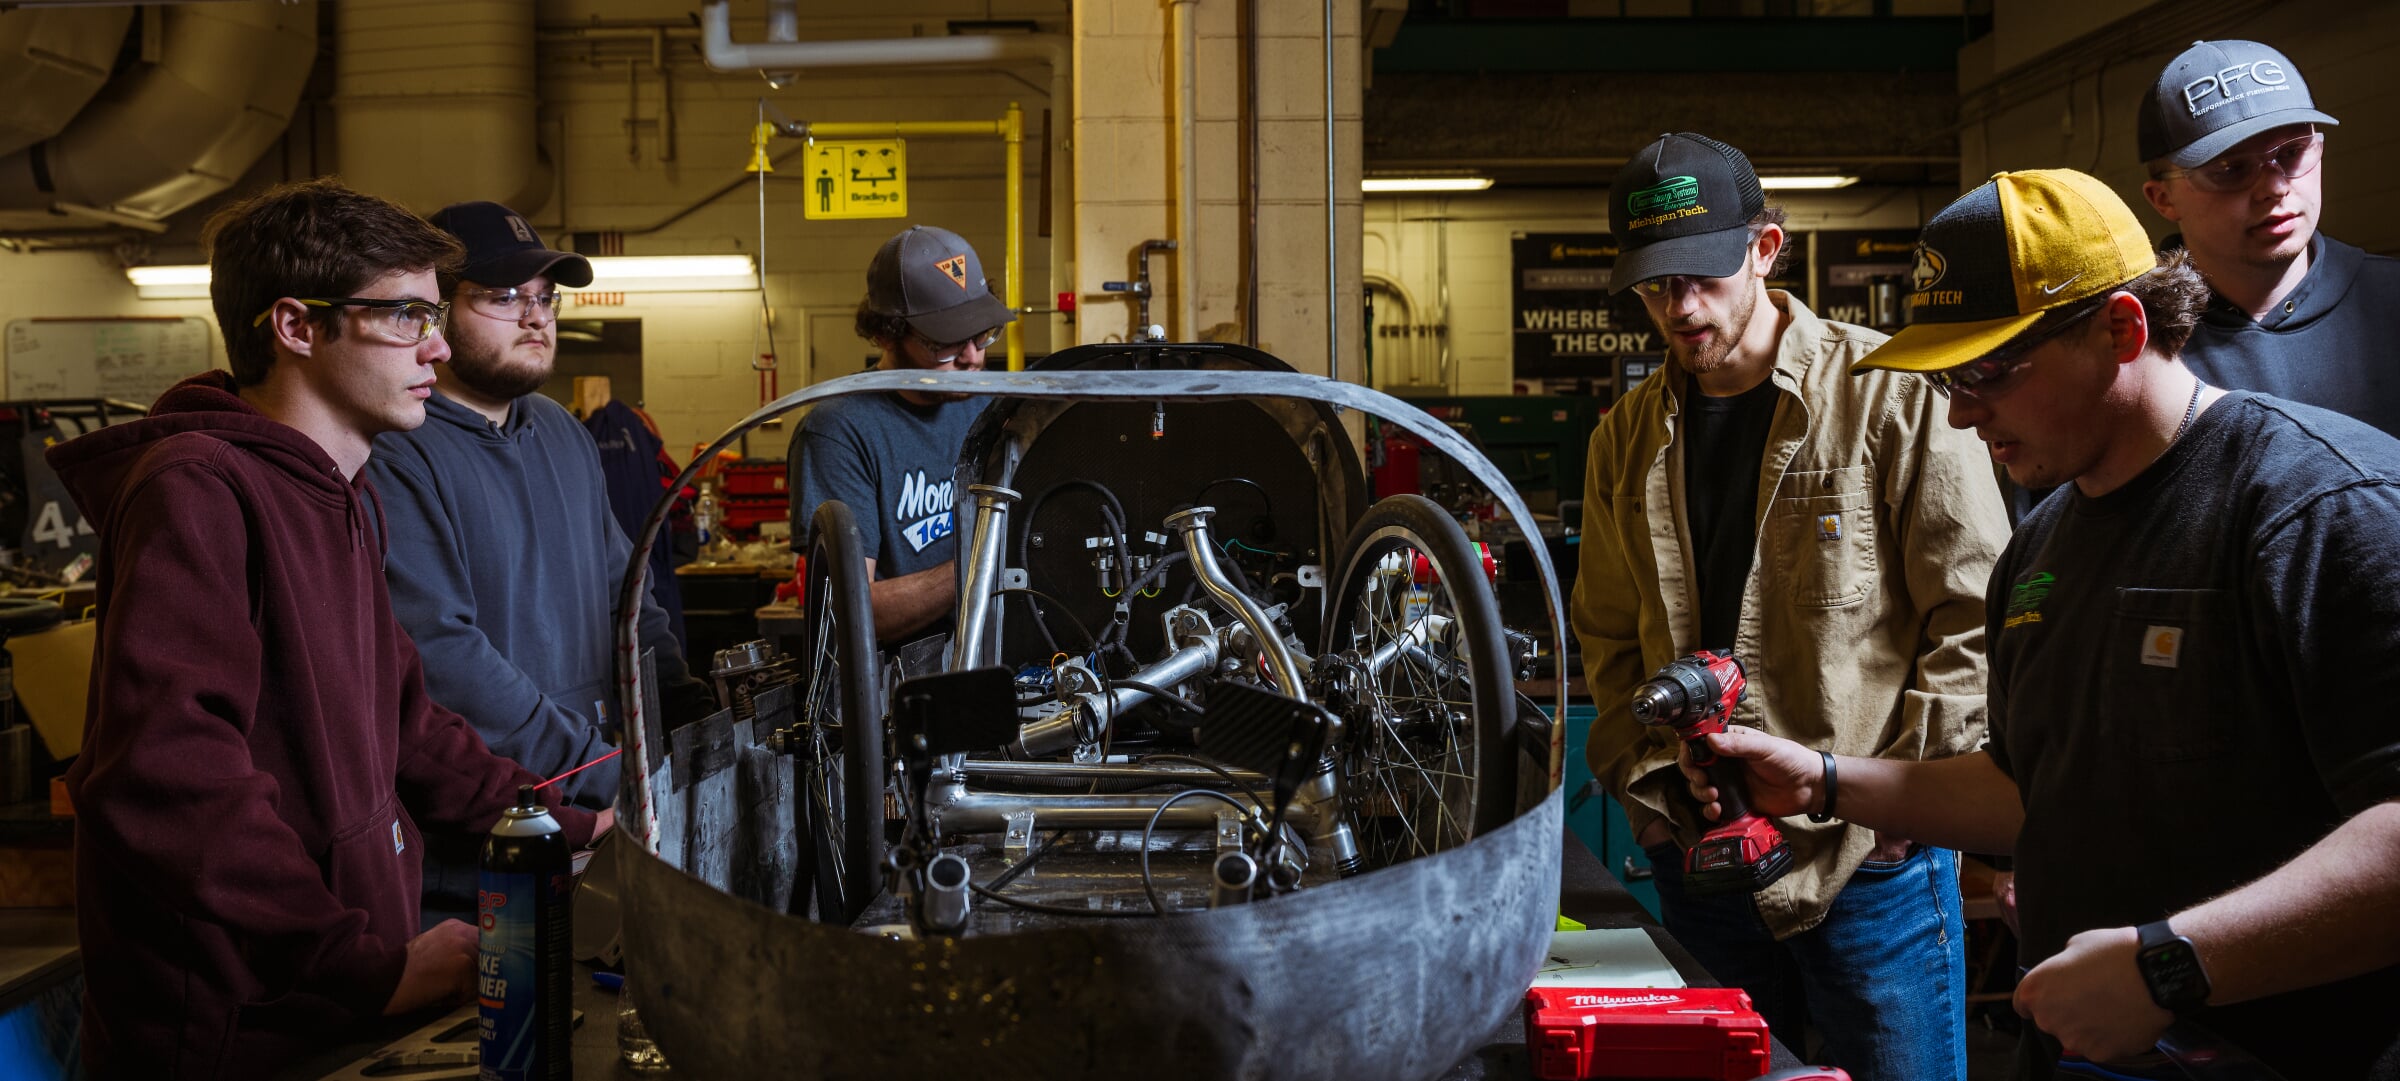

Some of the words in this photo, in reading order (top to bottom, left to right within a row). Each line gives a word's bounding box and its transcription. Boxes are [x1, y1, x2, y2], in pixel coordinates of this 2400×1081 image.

[2183, 60, 2287, 113] PFG
[2192, 94, 2245, 119] PERFORMANCE
[851, 192, 888, 202] Bradley
[1628, 212, 1677, 231] Michigan
[1932, 291, 1963, 306] TECH
[1522, 310, 1610, 329] WHERE
[1551, 333, 1651, 353] THEORY
[1566, 993, 1682, 1006] Milwaukee
